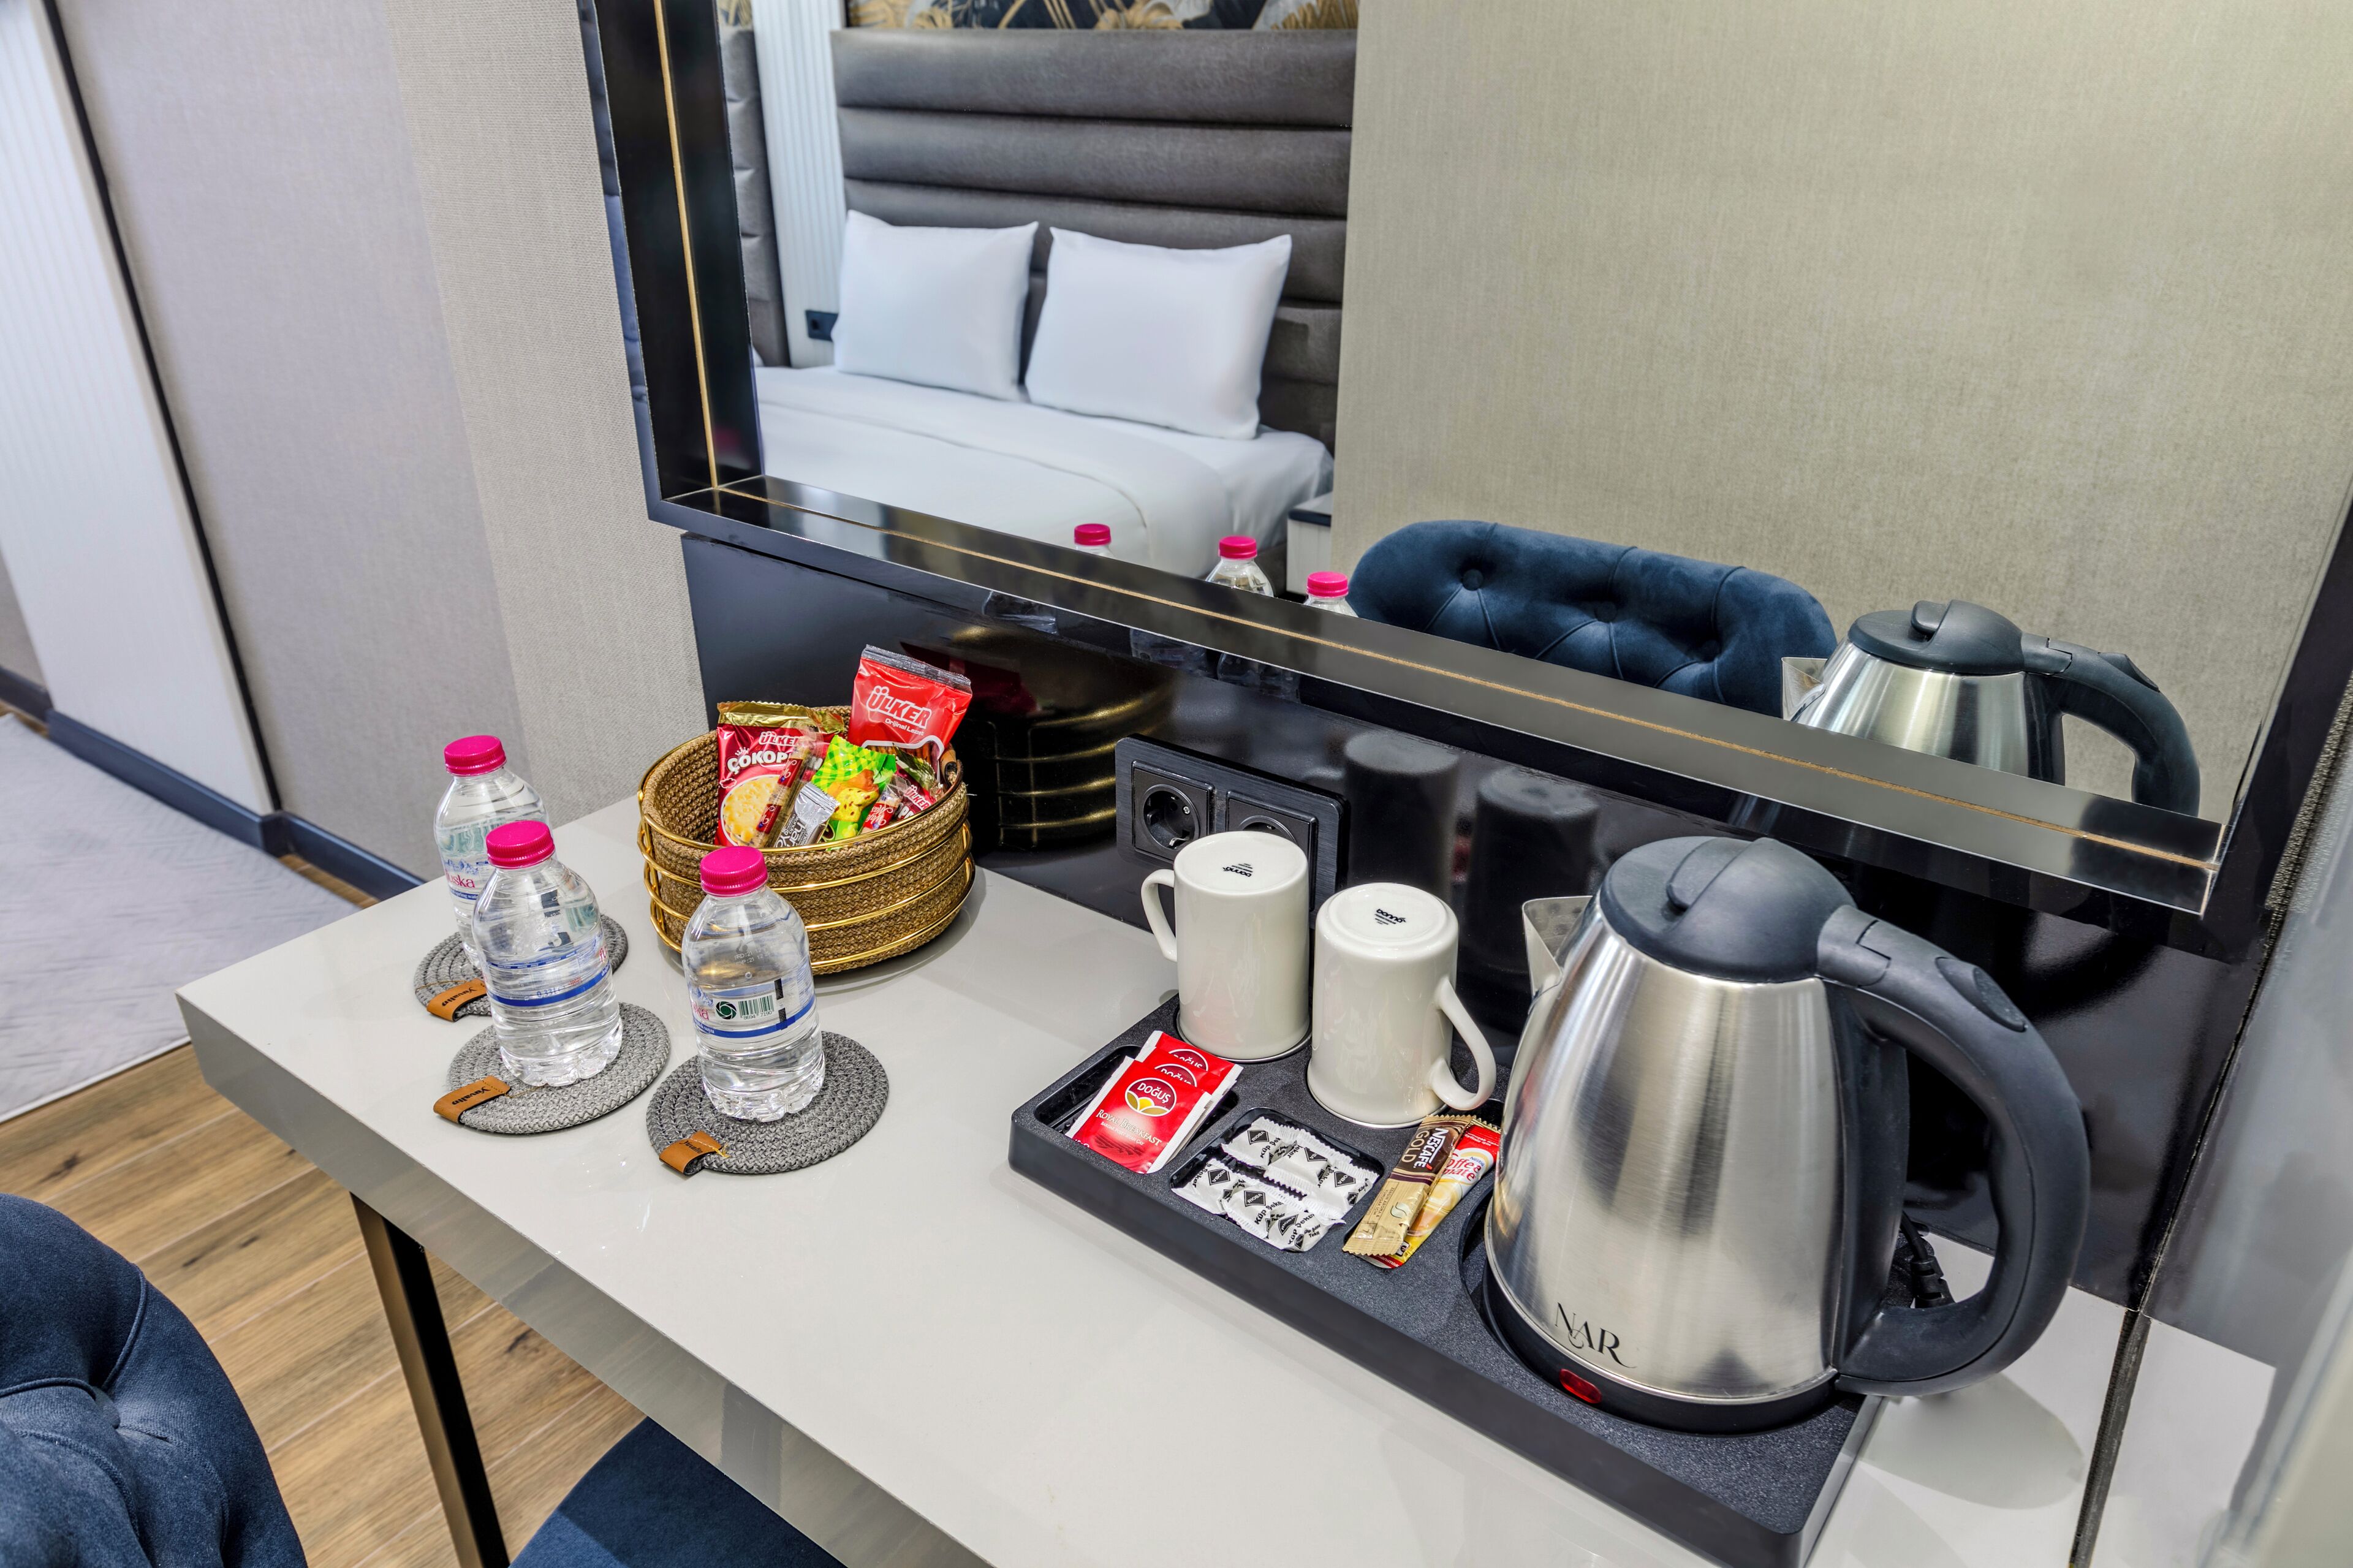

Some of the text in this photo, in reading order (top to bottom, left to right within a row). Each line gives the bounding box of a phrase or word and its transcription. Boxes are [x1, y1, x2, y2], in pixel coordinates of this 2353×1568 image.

[866, 685, 933, 729] ÜLKER
[884, 719, 907, 731] Orijinal
[1137, 1082, 1171, 1104] DOĞUŞ
[1096, 1109, 1162, 1146] ROYAL BREAKFAST
[1401, 1131, 1430, 1163] GOLD
[1447, 1153, 1482, 1173] offee
[1211, 1170, 1226, 1183] RIOBA
[1247, 1193, 1263, 1203] RIOBA
[1254, 1210, 1267, 1225] Küp
[1555, 1302, 1637, 1368] NAR
